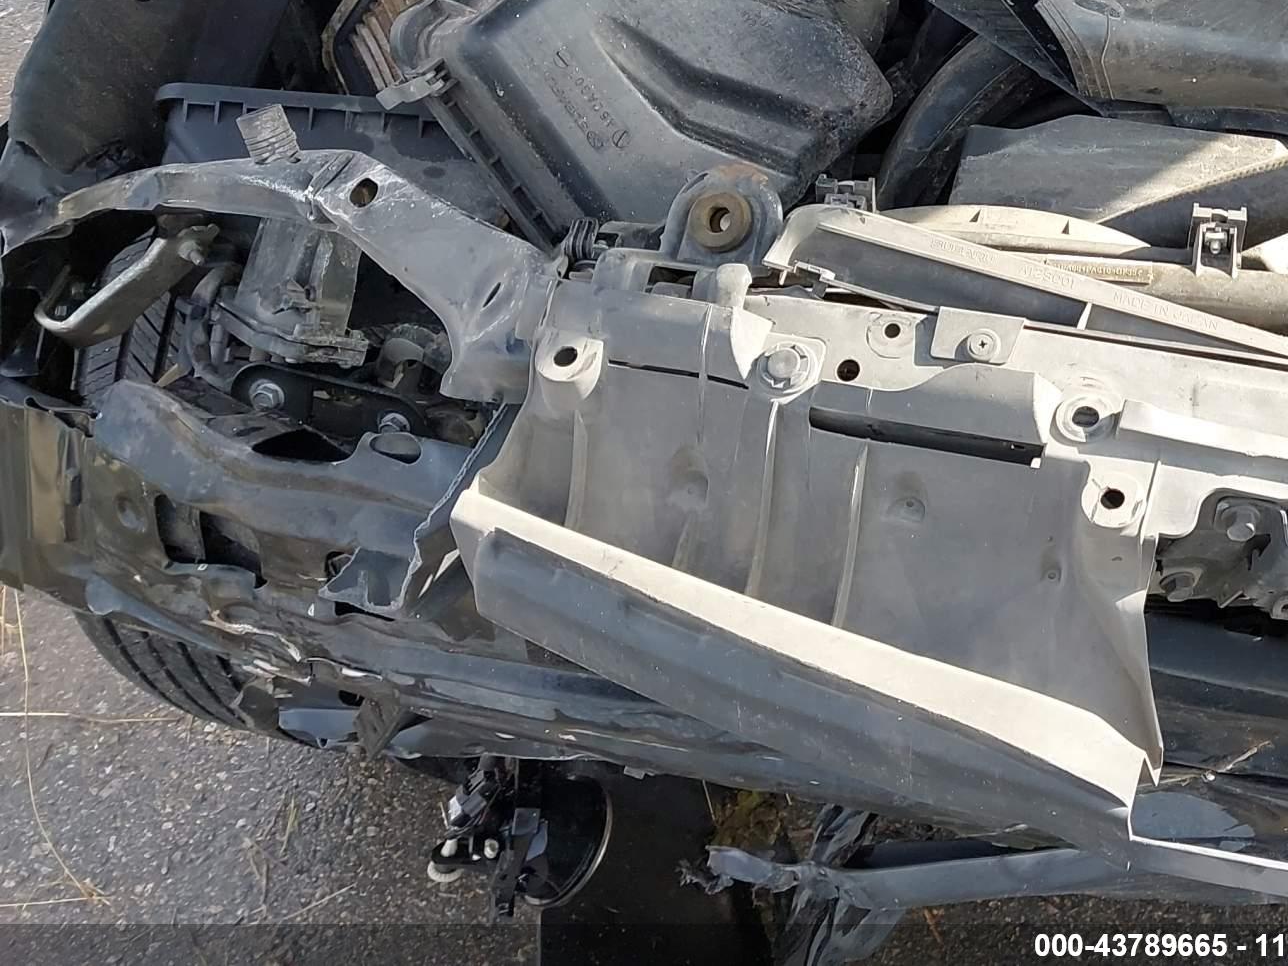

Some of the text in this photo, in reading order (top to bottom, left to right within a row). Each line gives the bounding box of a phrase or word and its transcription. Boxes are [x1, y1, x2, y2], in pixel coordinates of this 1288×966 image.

[930, 239, 997, 265] SUBARU
[1112, 291, 1219, 331] MADE IN JAPAN
